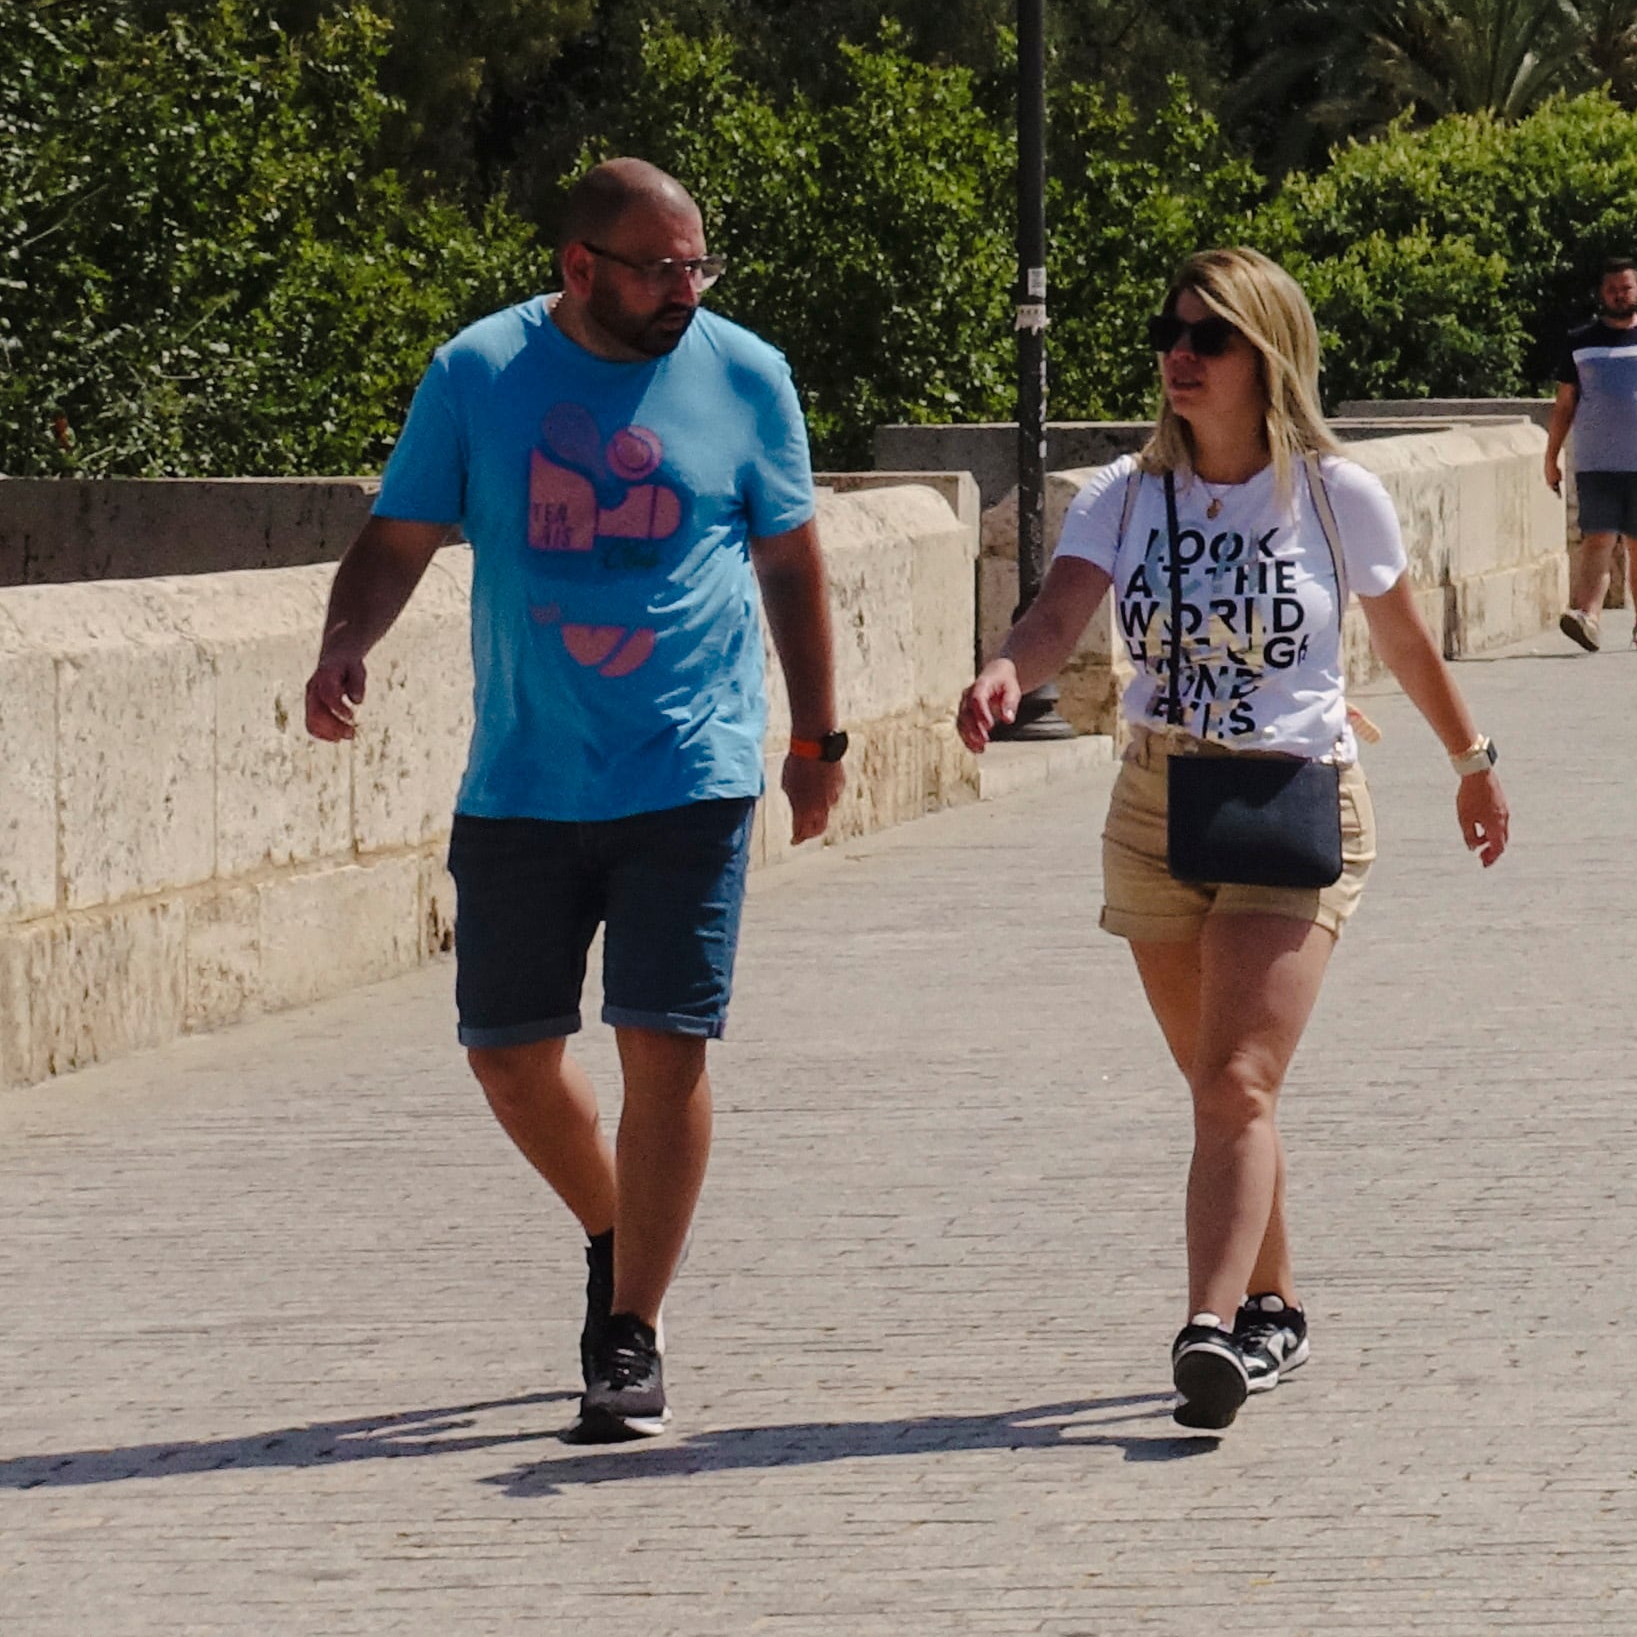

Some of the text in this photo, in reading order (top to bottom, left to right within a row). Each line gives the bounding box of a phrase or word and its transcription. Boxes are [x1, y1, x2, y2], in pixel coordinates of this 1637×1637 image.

[1145, 526, 1279, 565] LOOK
[1124, 562, 1190, 599] AT
[1204, 560, 1298, 595] THE
[1120, 596, 1305, 638] WORLD
